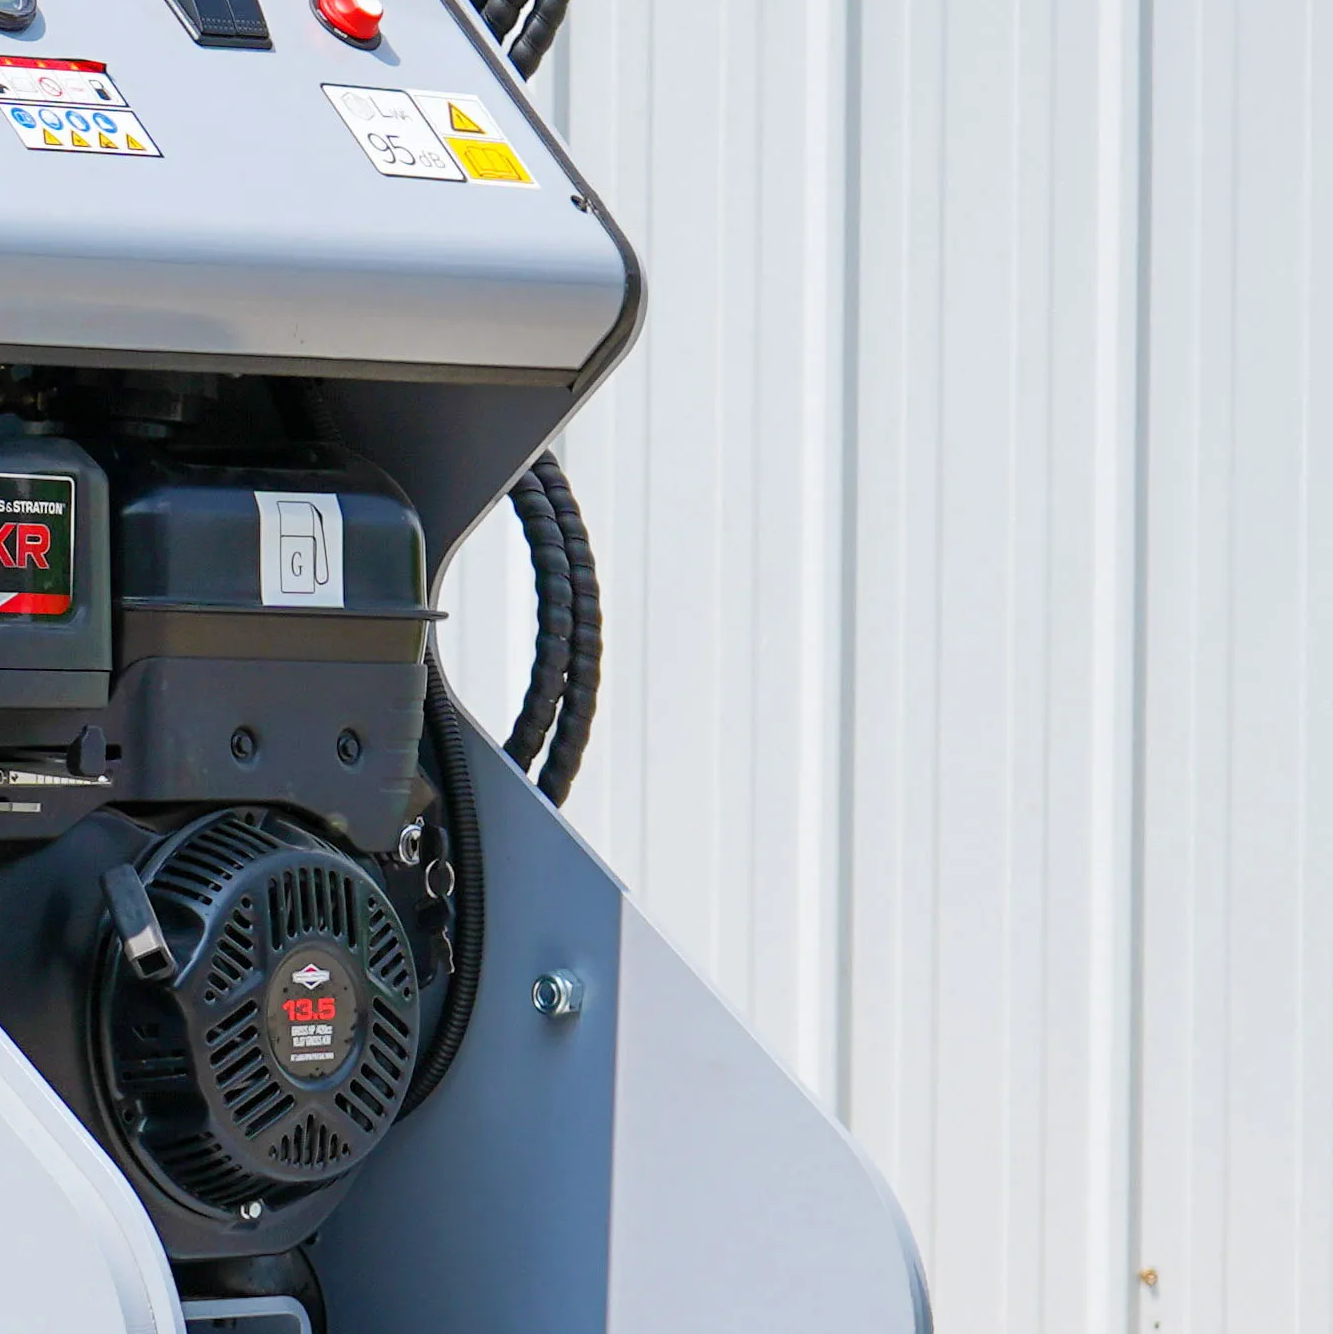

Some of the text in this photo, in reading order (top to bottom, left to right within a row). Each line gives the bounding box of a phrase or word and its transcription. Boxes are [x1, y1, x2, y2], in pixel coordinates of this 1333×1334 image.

[367, 132, 446, 169] 95 dB
[290, 551, 304, 577] G
[282, 997, 337, 1021] 13.5
